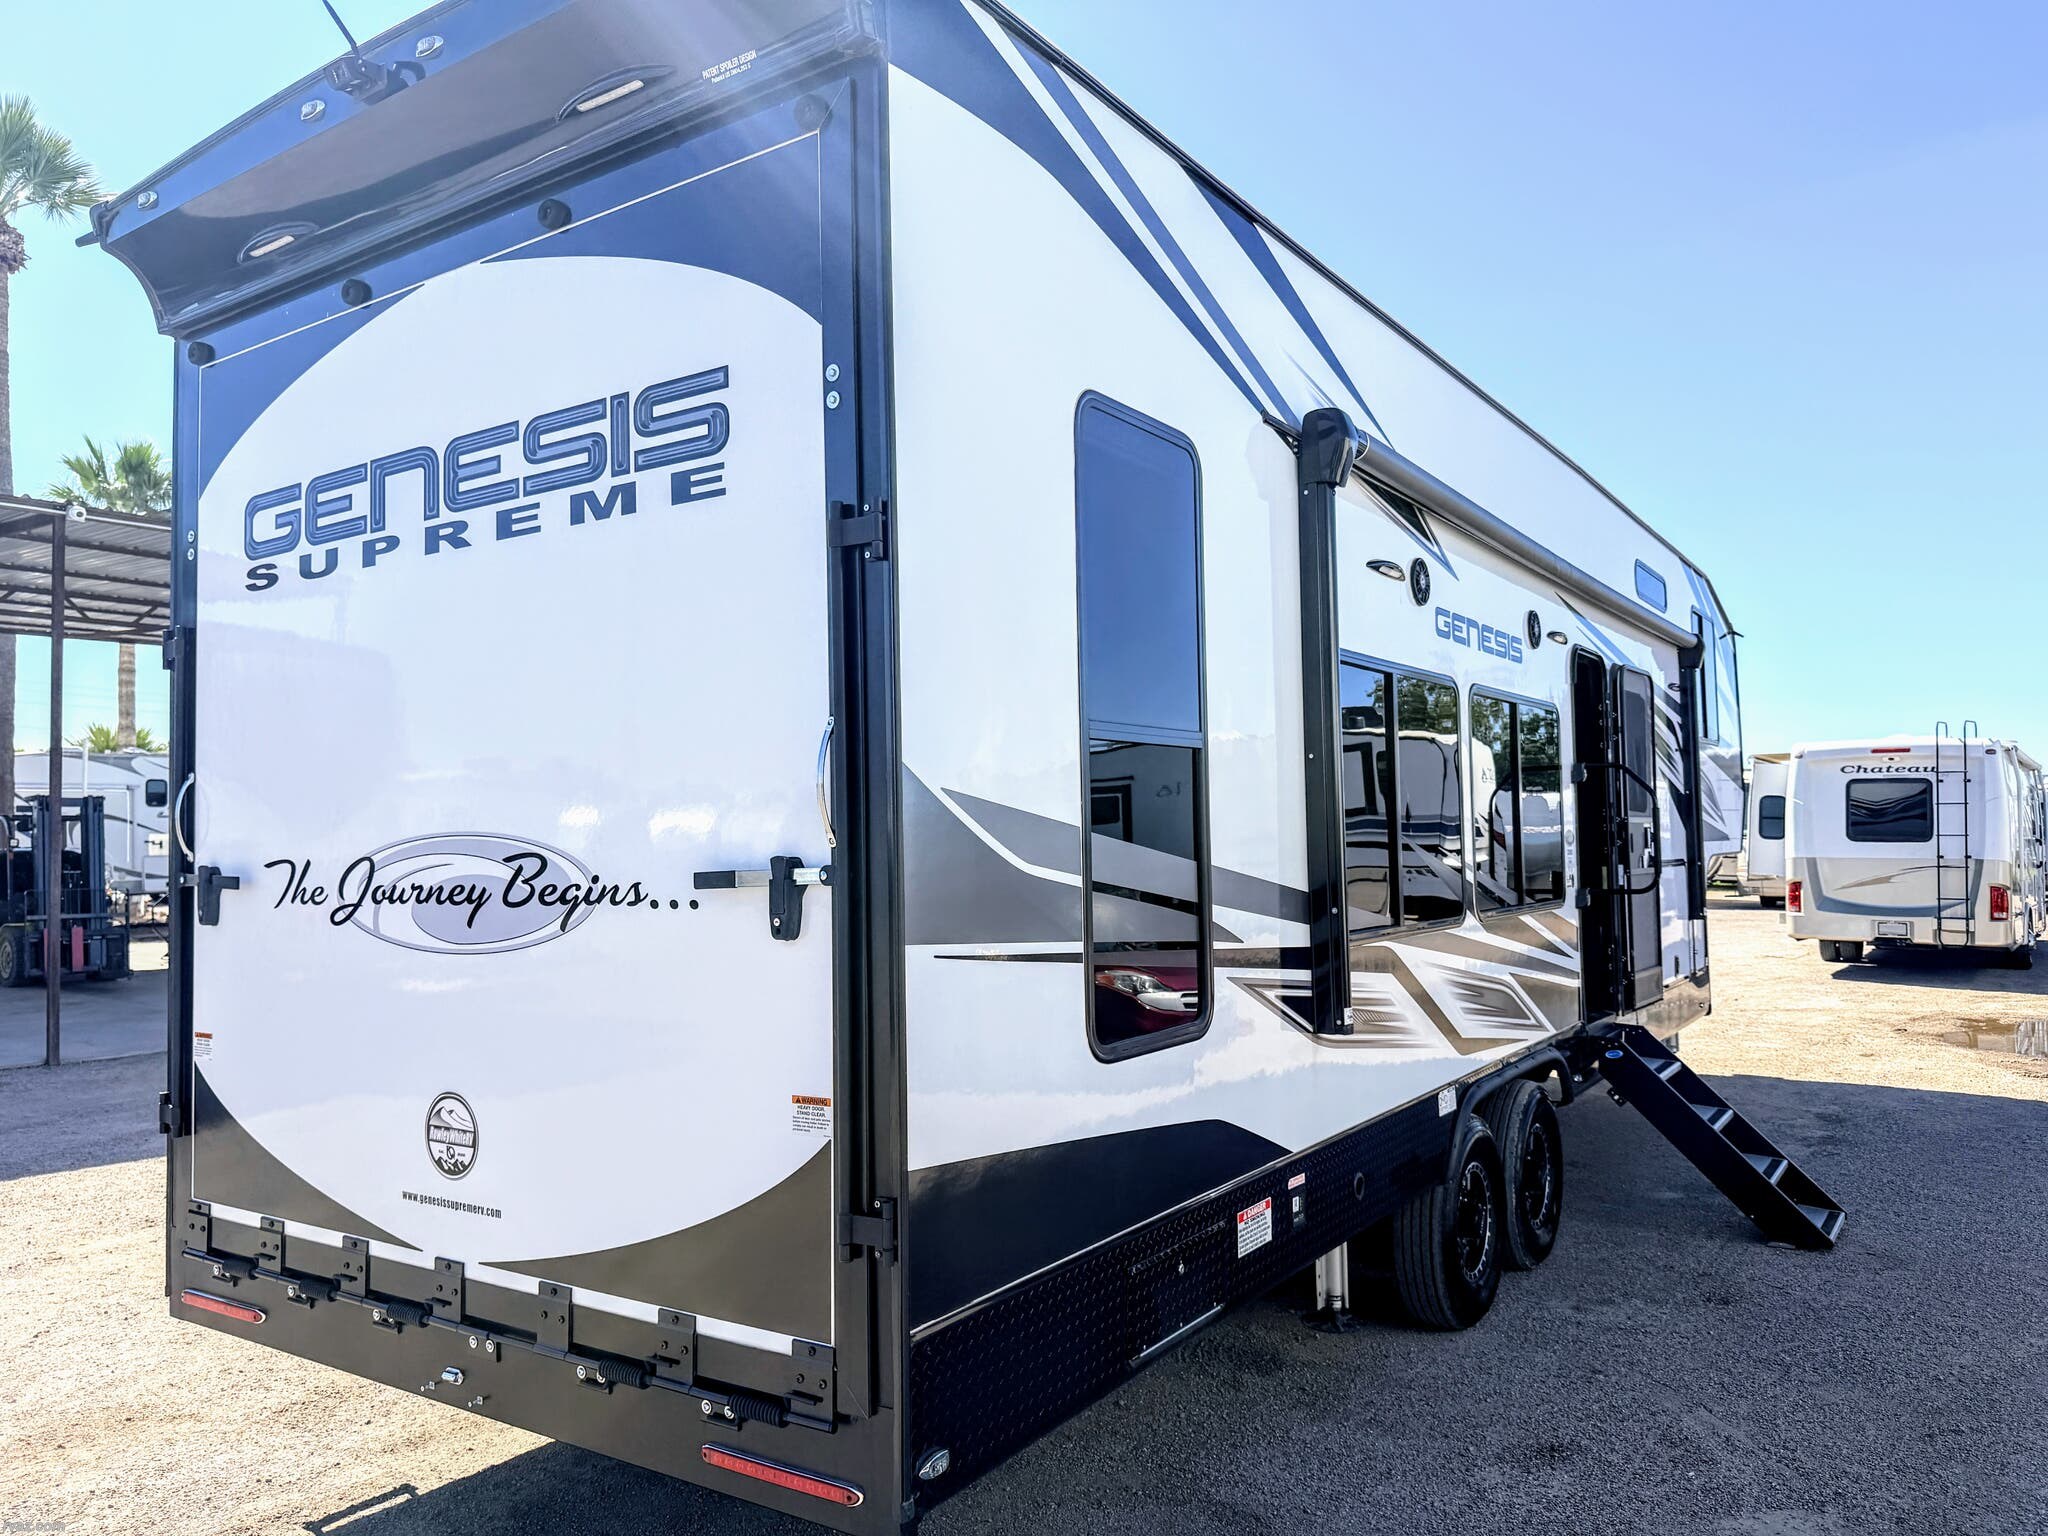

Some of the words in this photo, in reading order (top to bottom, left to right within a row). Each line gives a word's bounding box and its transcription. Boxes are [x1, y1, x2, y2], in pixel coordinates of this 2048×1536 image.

[702, 65, 720, 80] PATENT
[719, 57, 739, 72] SPOILER
[739, 49, 757, 64] DESIGN
[244, 365, 729, 561] GENESIS
[245, 461, 727, 592] SUPREME
[1435, 606, 1523, 664] GENESIS
[1840, 765, 1937, 775] Chateau
[264, 858, 329, 909] The
[329, 856, 492, 929] Journey
[502, 852, 700, 932] Begins...
[802, 1096, 828, 1106] WARNING
[402, 1190, 502, 1219] www.genesissupremerv.com
